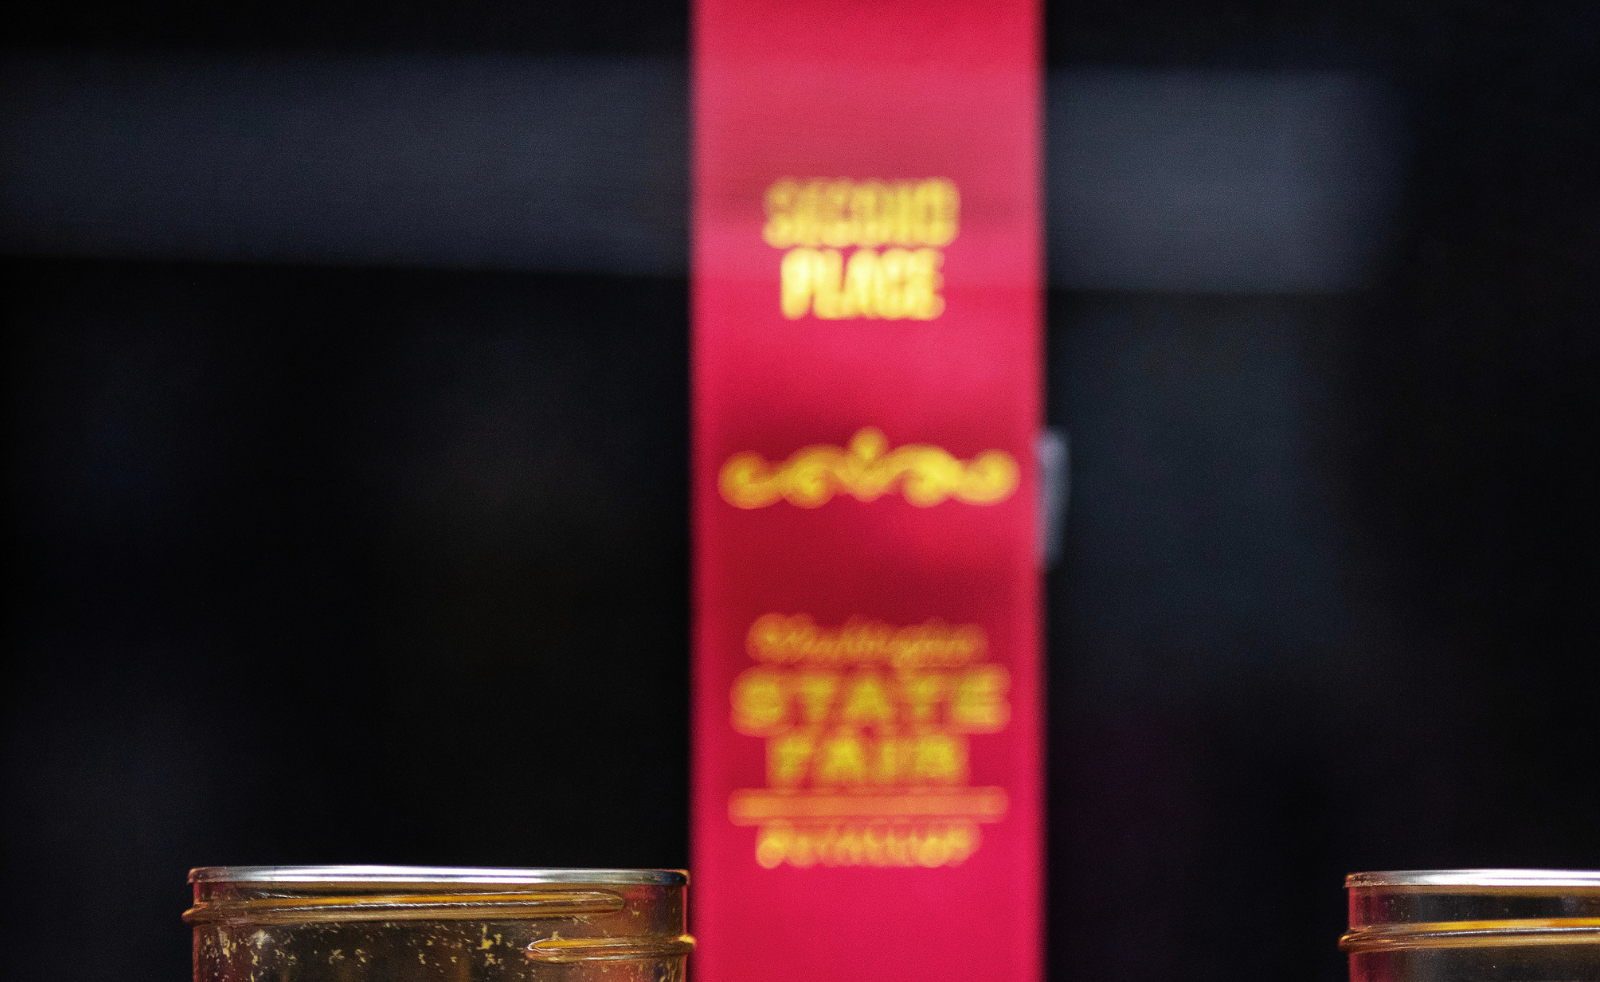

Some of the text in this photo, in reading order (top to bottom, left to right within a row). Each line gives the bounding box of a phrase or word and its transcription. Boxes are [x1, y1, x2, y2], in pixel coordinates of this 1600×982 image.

[780, 249, 945, 321] PLACE
[731, 665, 1011, 735] STATE
[766, 735, 970, 788] FAIR
